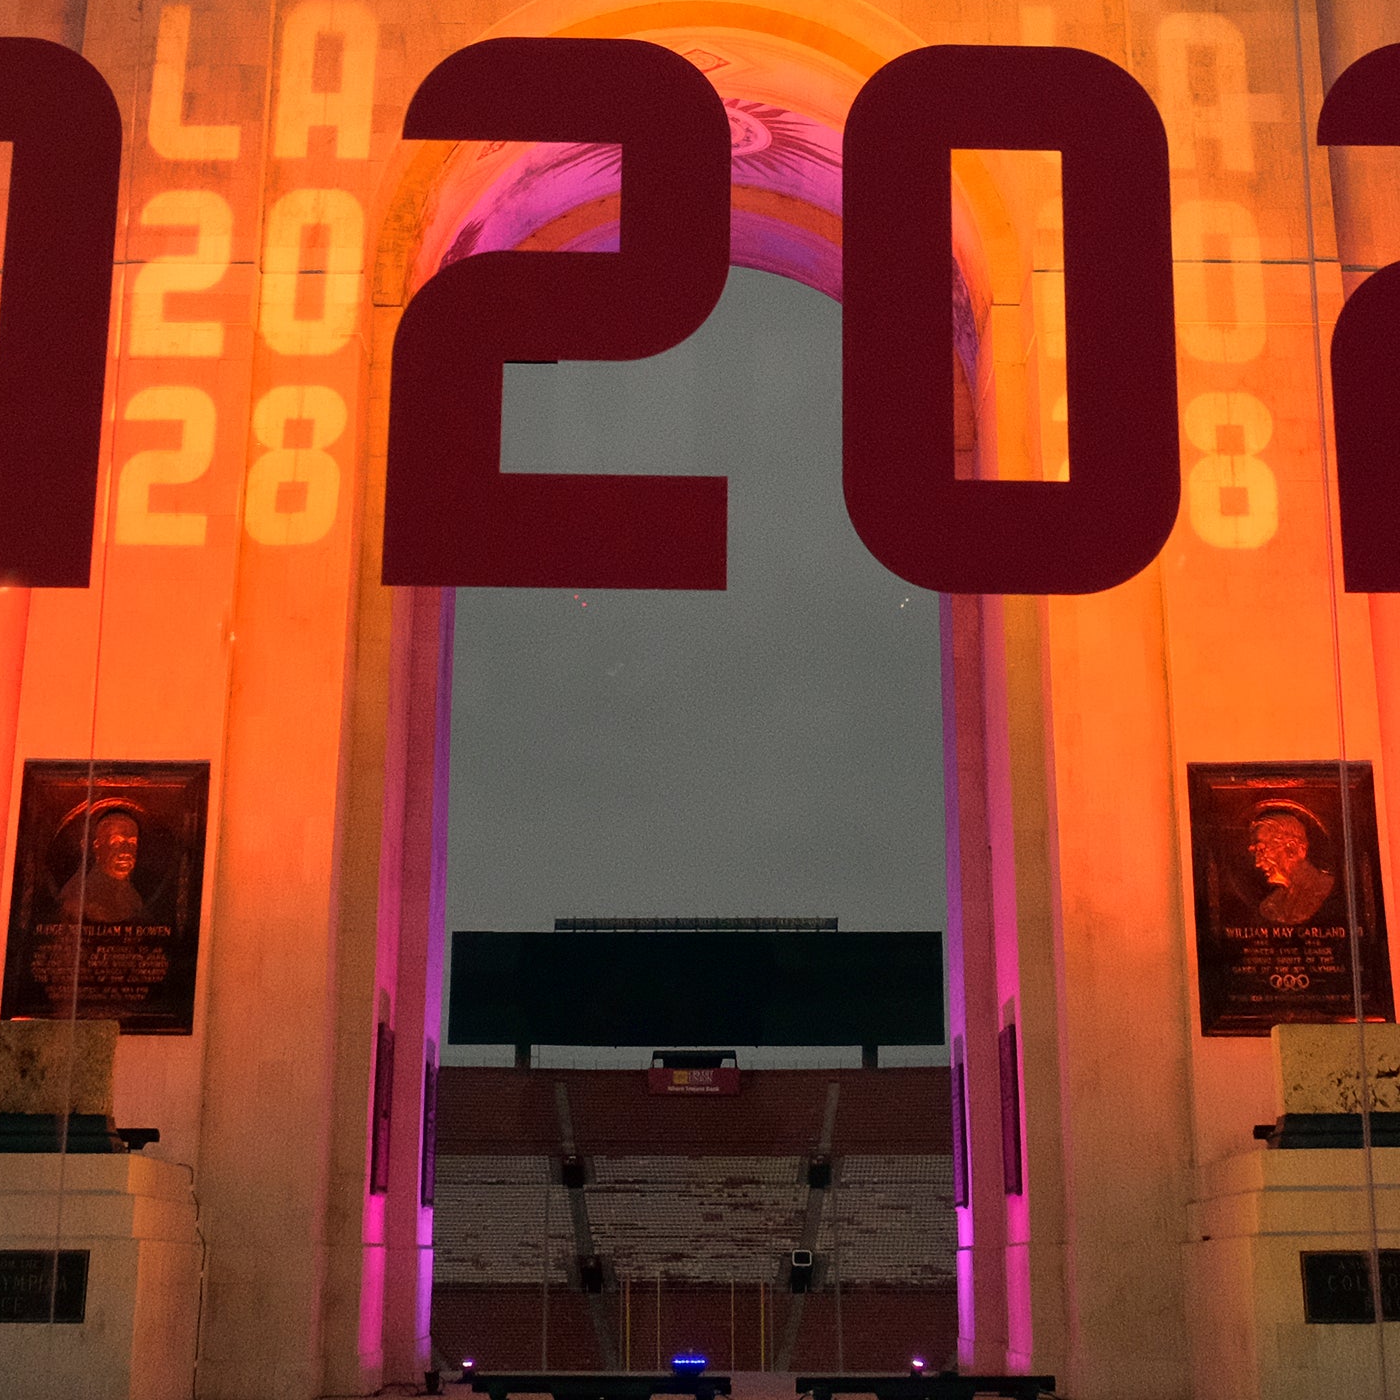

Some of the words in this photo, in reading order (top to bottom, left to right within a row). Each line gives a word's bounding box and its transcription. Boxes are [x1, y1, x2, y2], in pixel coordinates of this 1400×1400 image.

[148, 2, 378, 160] LA
[129, 188, 364, 357] 20
[114, 384, 348, 547] 28
[136, 925, 171, 937] BOWEN
[1225, 927, 1269, 939] WILLIAM
[1272, 927, 1294, 938] MAY
